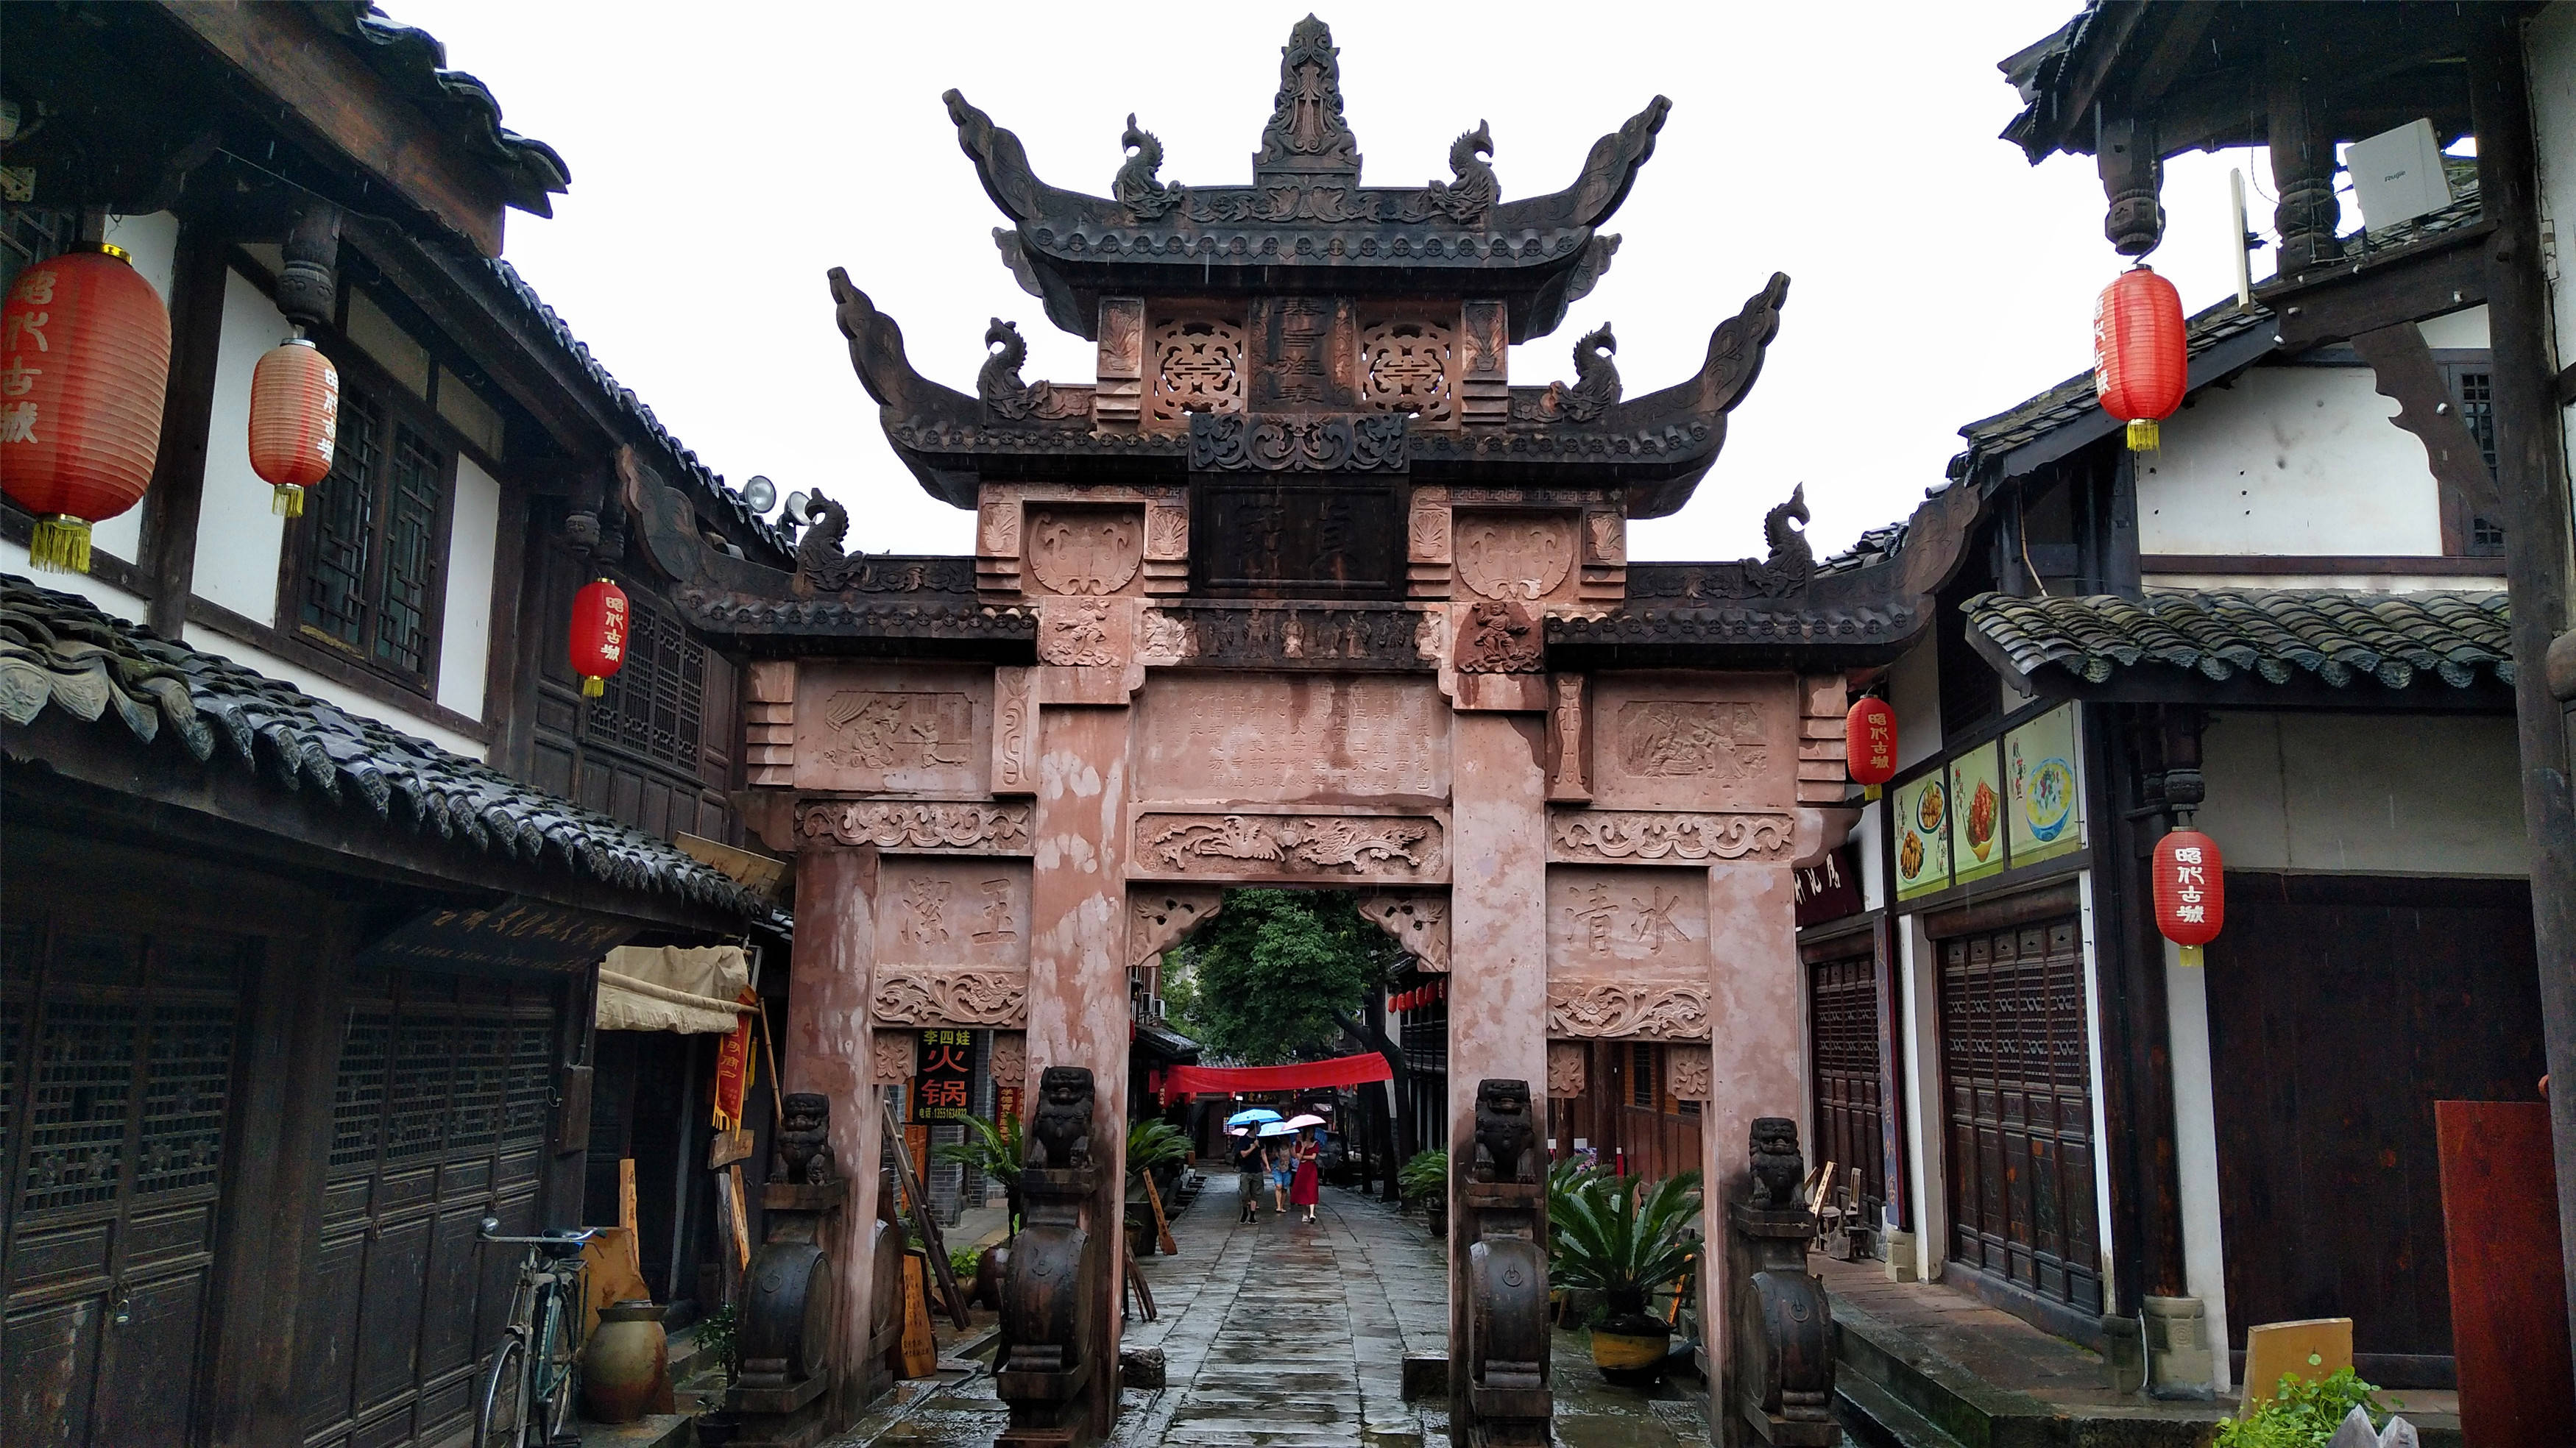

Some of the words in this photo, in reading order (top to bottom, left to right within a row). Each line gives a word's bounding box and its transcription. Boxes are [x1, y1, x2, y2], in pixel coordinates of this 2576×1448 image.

[1868, 713, 1889, 769] 昭化古城
[2176, 848, 2205, 923] 昭化古城
[923, 1030, 970, 1046] 李四娃
[921, 1046, 969, 1107] 火锅
